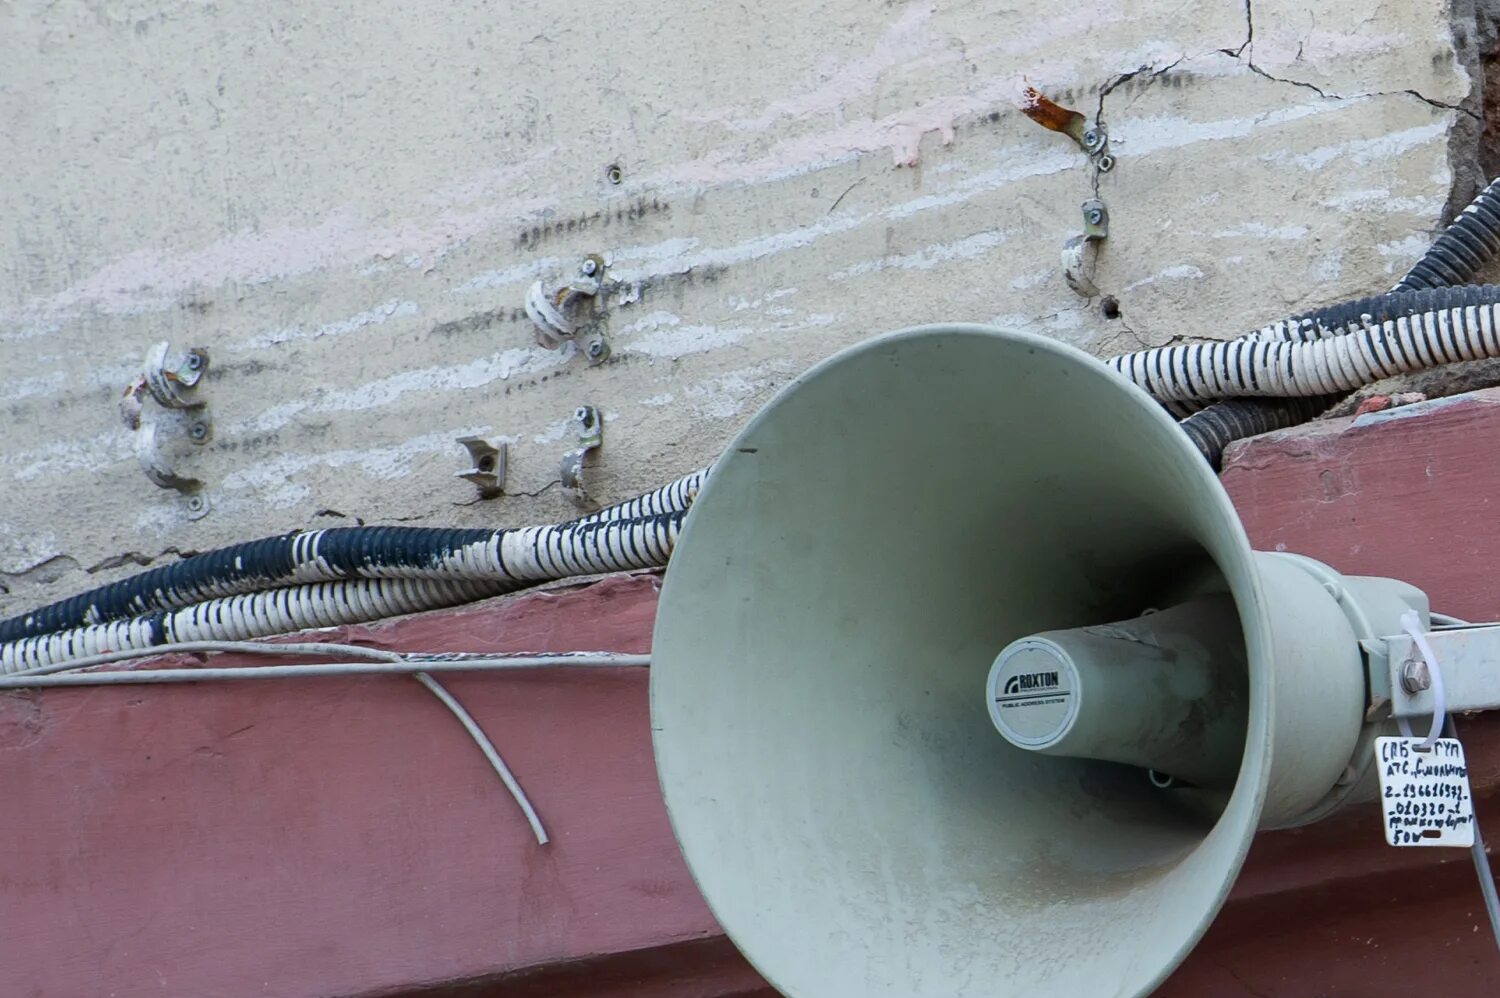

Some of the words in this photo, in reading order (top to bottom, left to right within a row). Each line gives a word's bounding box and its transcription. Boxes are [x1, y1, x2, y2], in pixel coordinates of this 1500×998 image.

[1020, 671, 1059, 688] ROXTON
[1020, 699, 1045, 707] ADDRESS
[1045, 698, 1065, 706] SYSTEM
